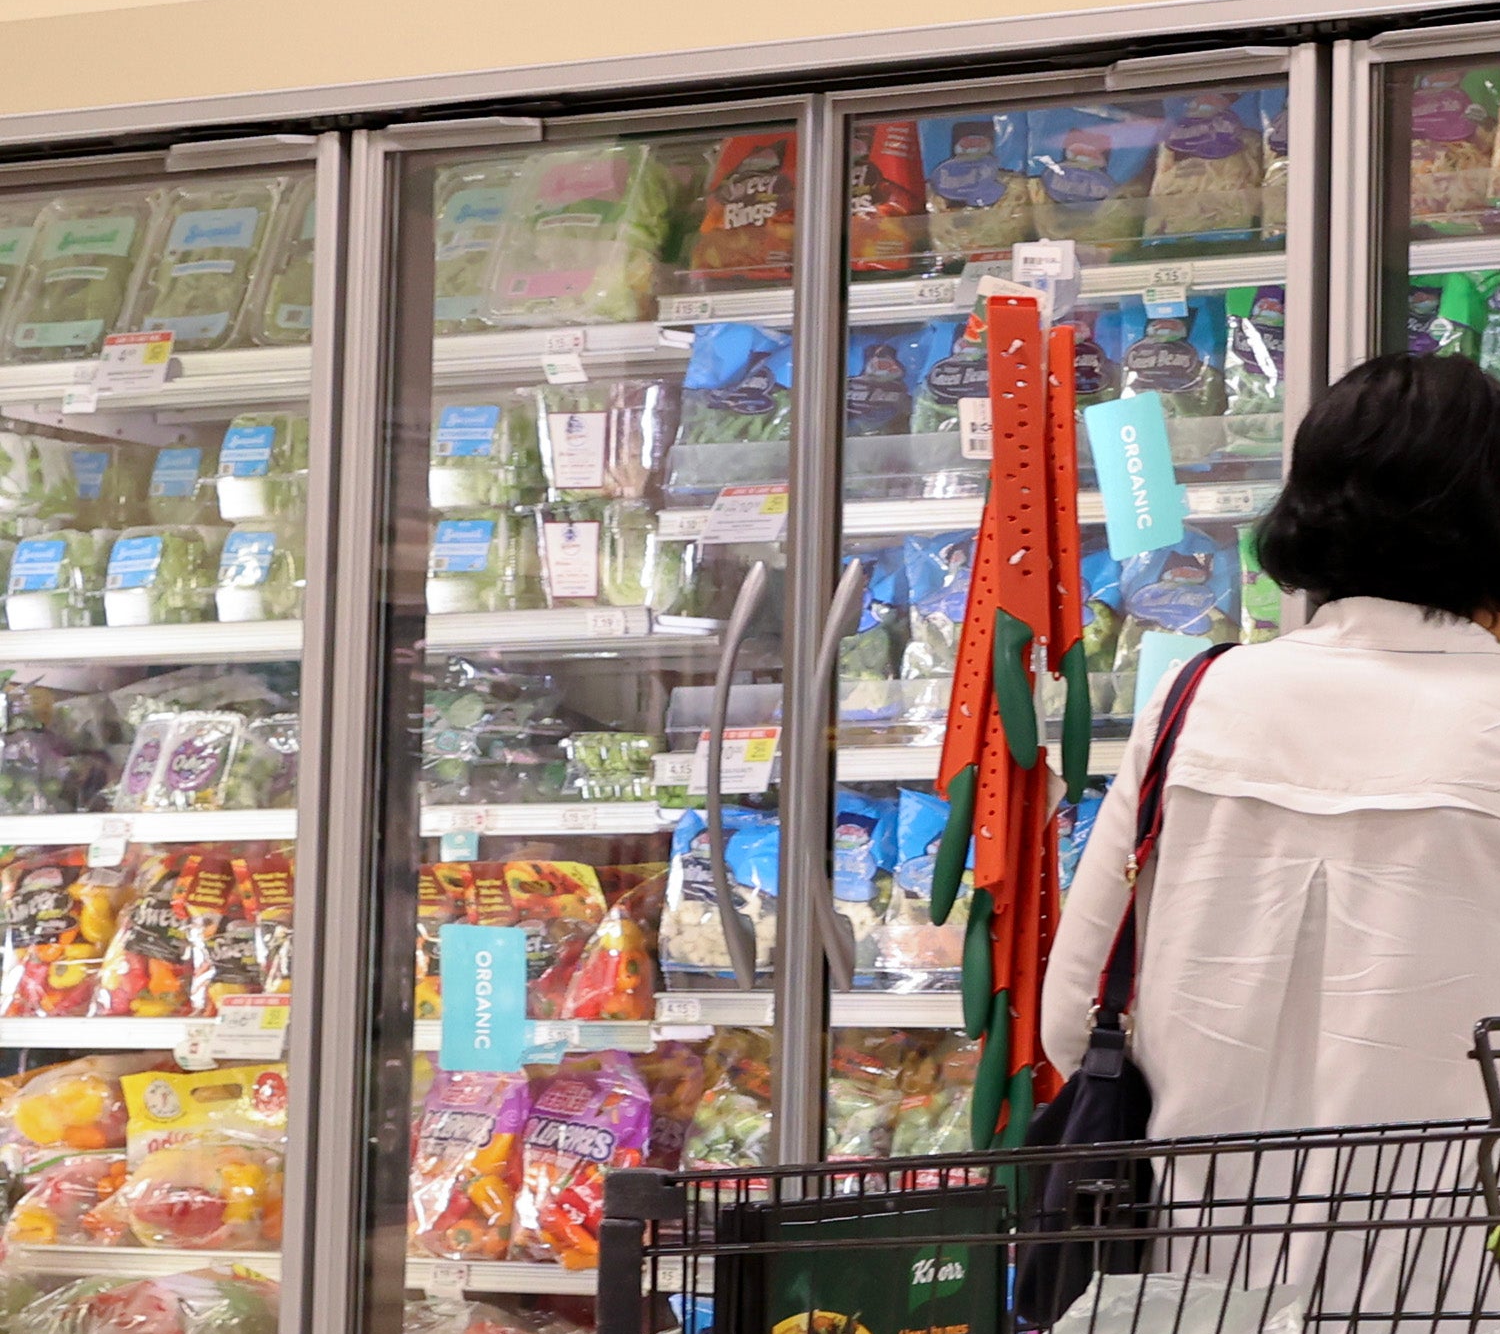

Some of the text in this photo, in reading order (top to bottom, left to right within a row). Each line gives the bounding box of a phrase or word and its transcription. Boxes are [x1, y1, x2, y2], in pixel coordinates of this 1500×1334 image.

[723, 201, 778, 230] Rings
[1119, 424, 1154, 530] ORGANIC
[473, 948, 492, 1052] ORGANIC
